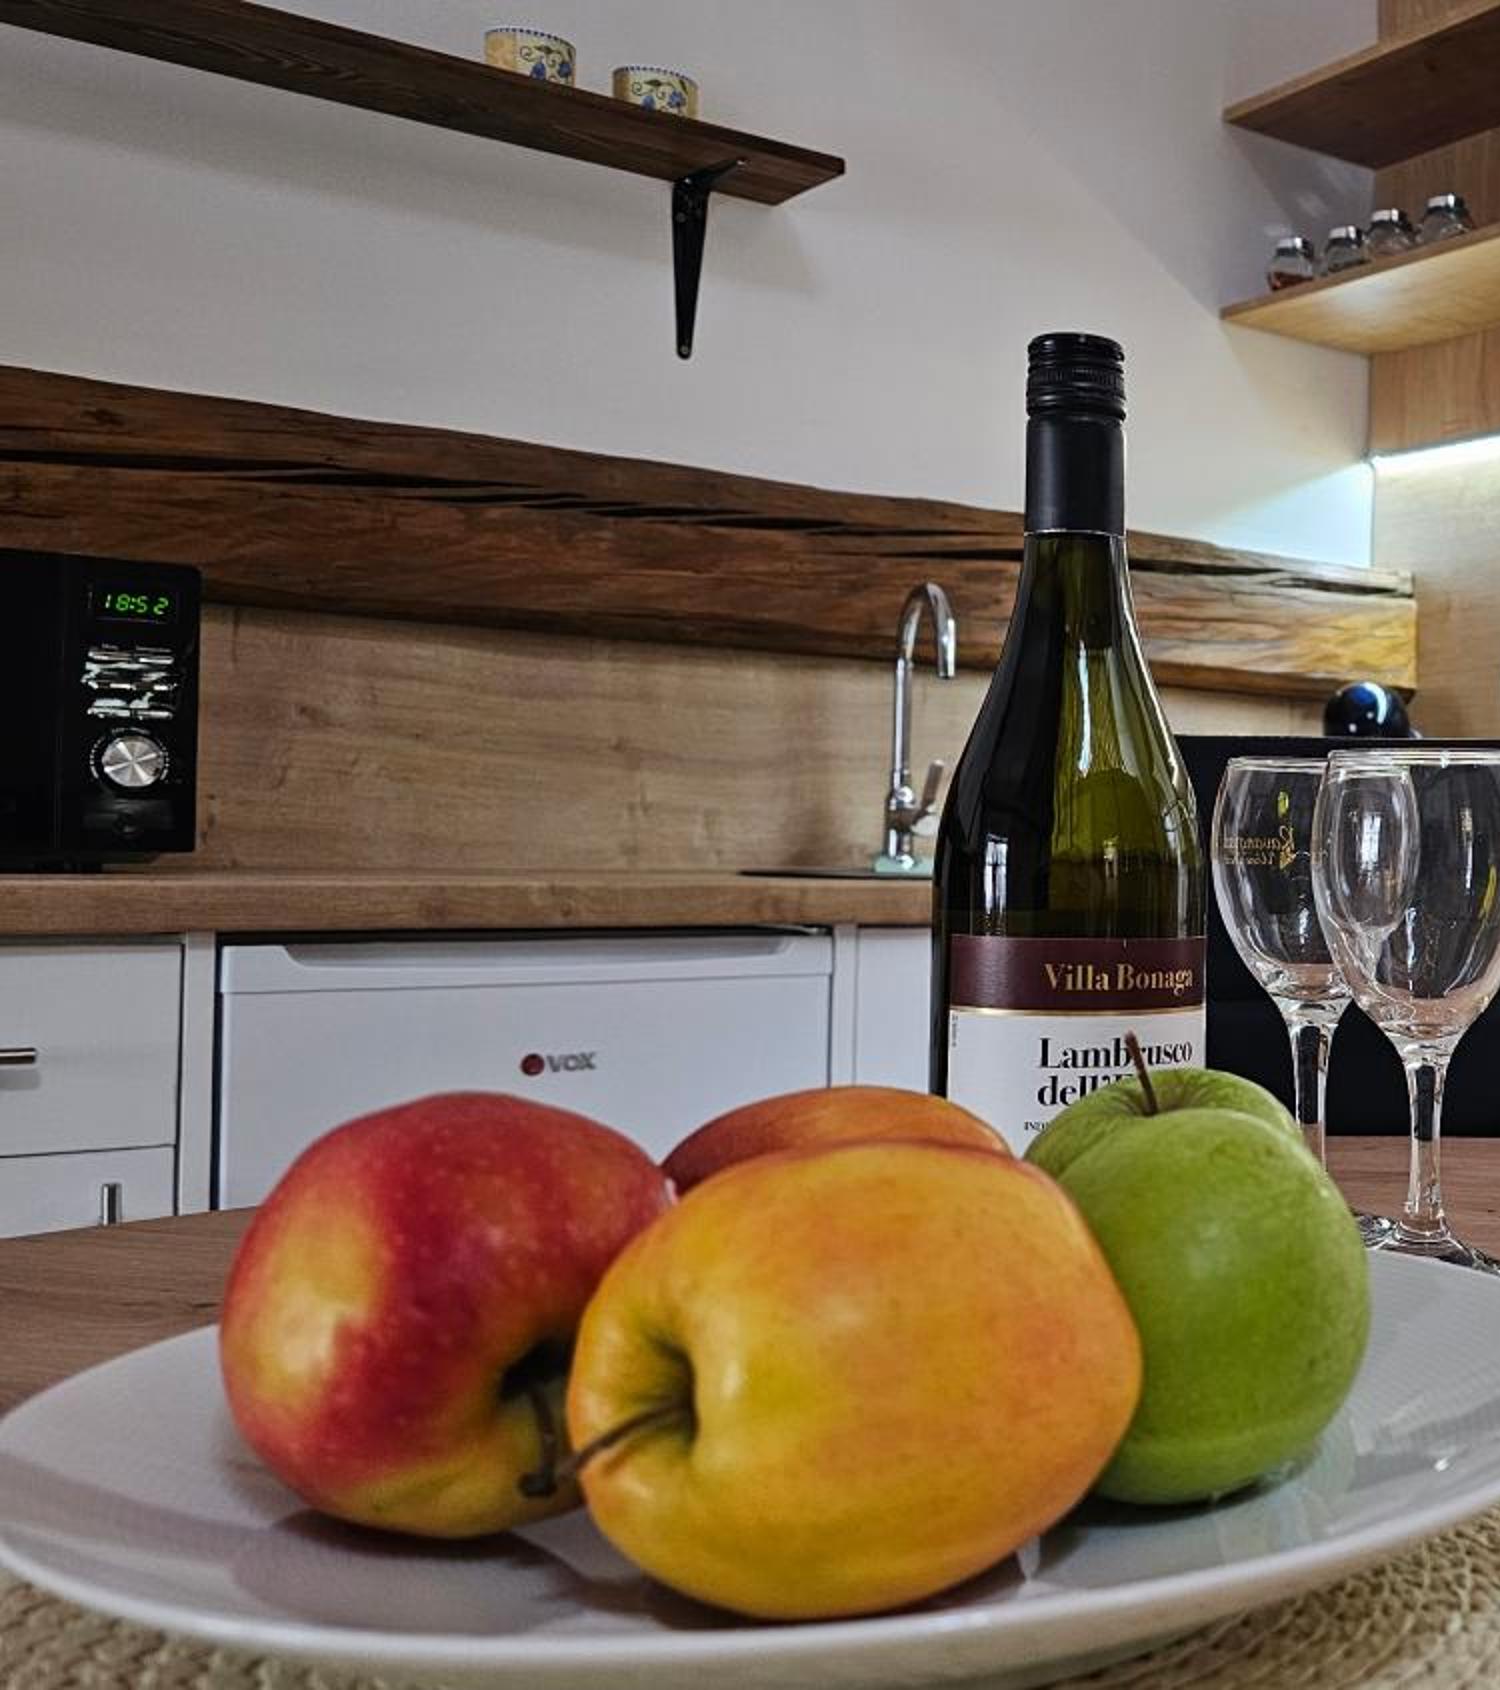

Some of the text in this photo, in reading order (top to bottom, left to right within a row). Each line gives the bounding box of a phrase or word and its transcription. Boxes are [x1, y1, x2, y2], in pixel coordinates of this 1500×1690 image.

[105, 593, 169, 615] 18:52
[1044, 963, 1193, 996] Villa Bonaga
[545, 1051, 597, 1073] VOX
